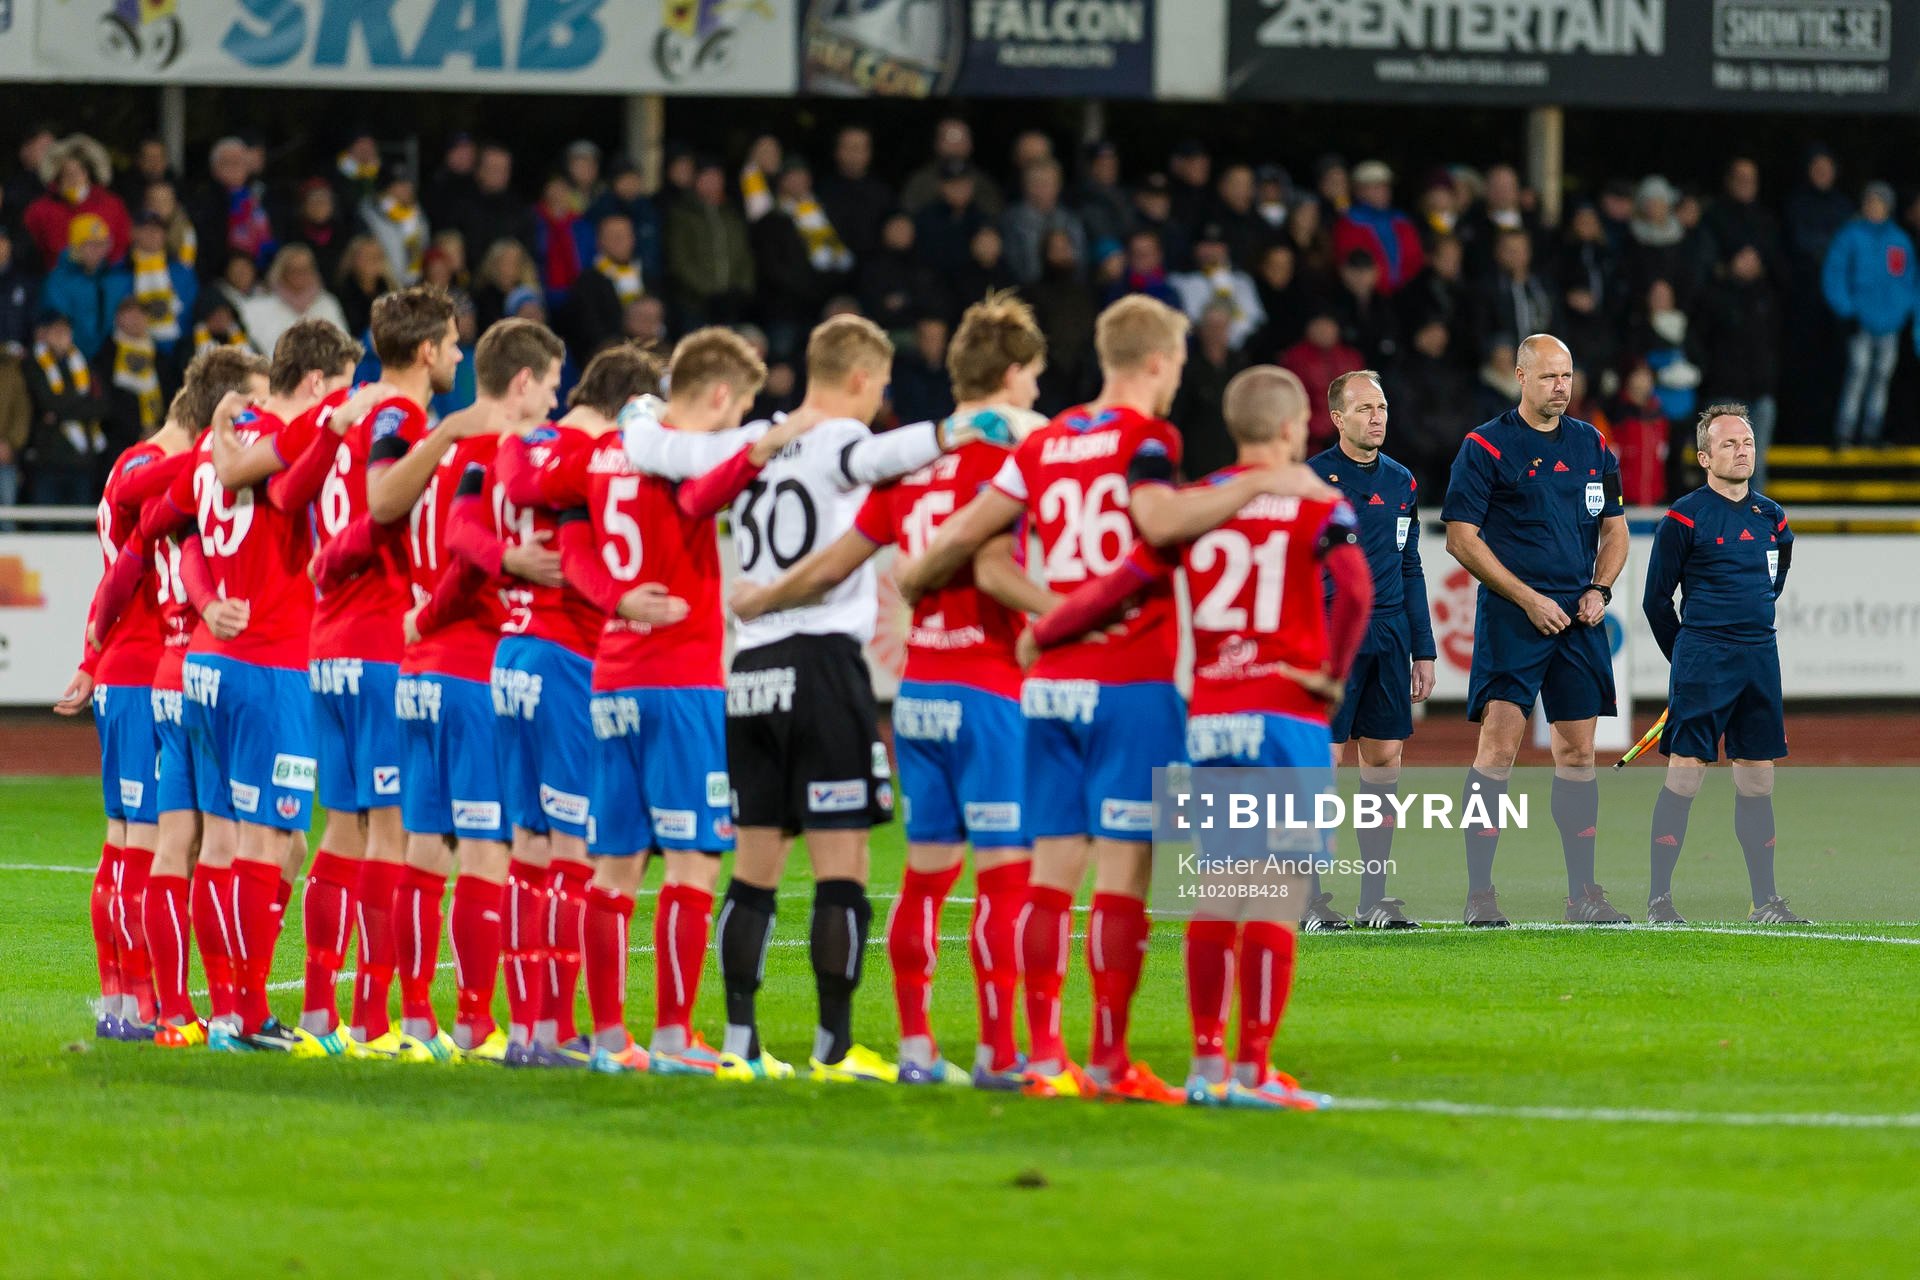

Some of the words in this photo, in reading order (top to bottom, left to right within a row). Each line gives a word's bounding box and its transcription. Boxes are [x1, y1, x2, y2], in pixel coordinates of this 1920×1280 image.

[970, 0, 1144, 43] FALCON
[192, 462, 255, 558] 29
[320, 442, 351, 537] 6
[601, 475, 644, 582] 5
[1038, 472, 1134, 583] 26
[1588, 495, 1603, 503] FIFA
[1189, 528, 1291, 634] 21
